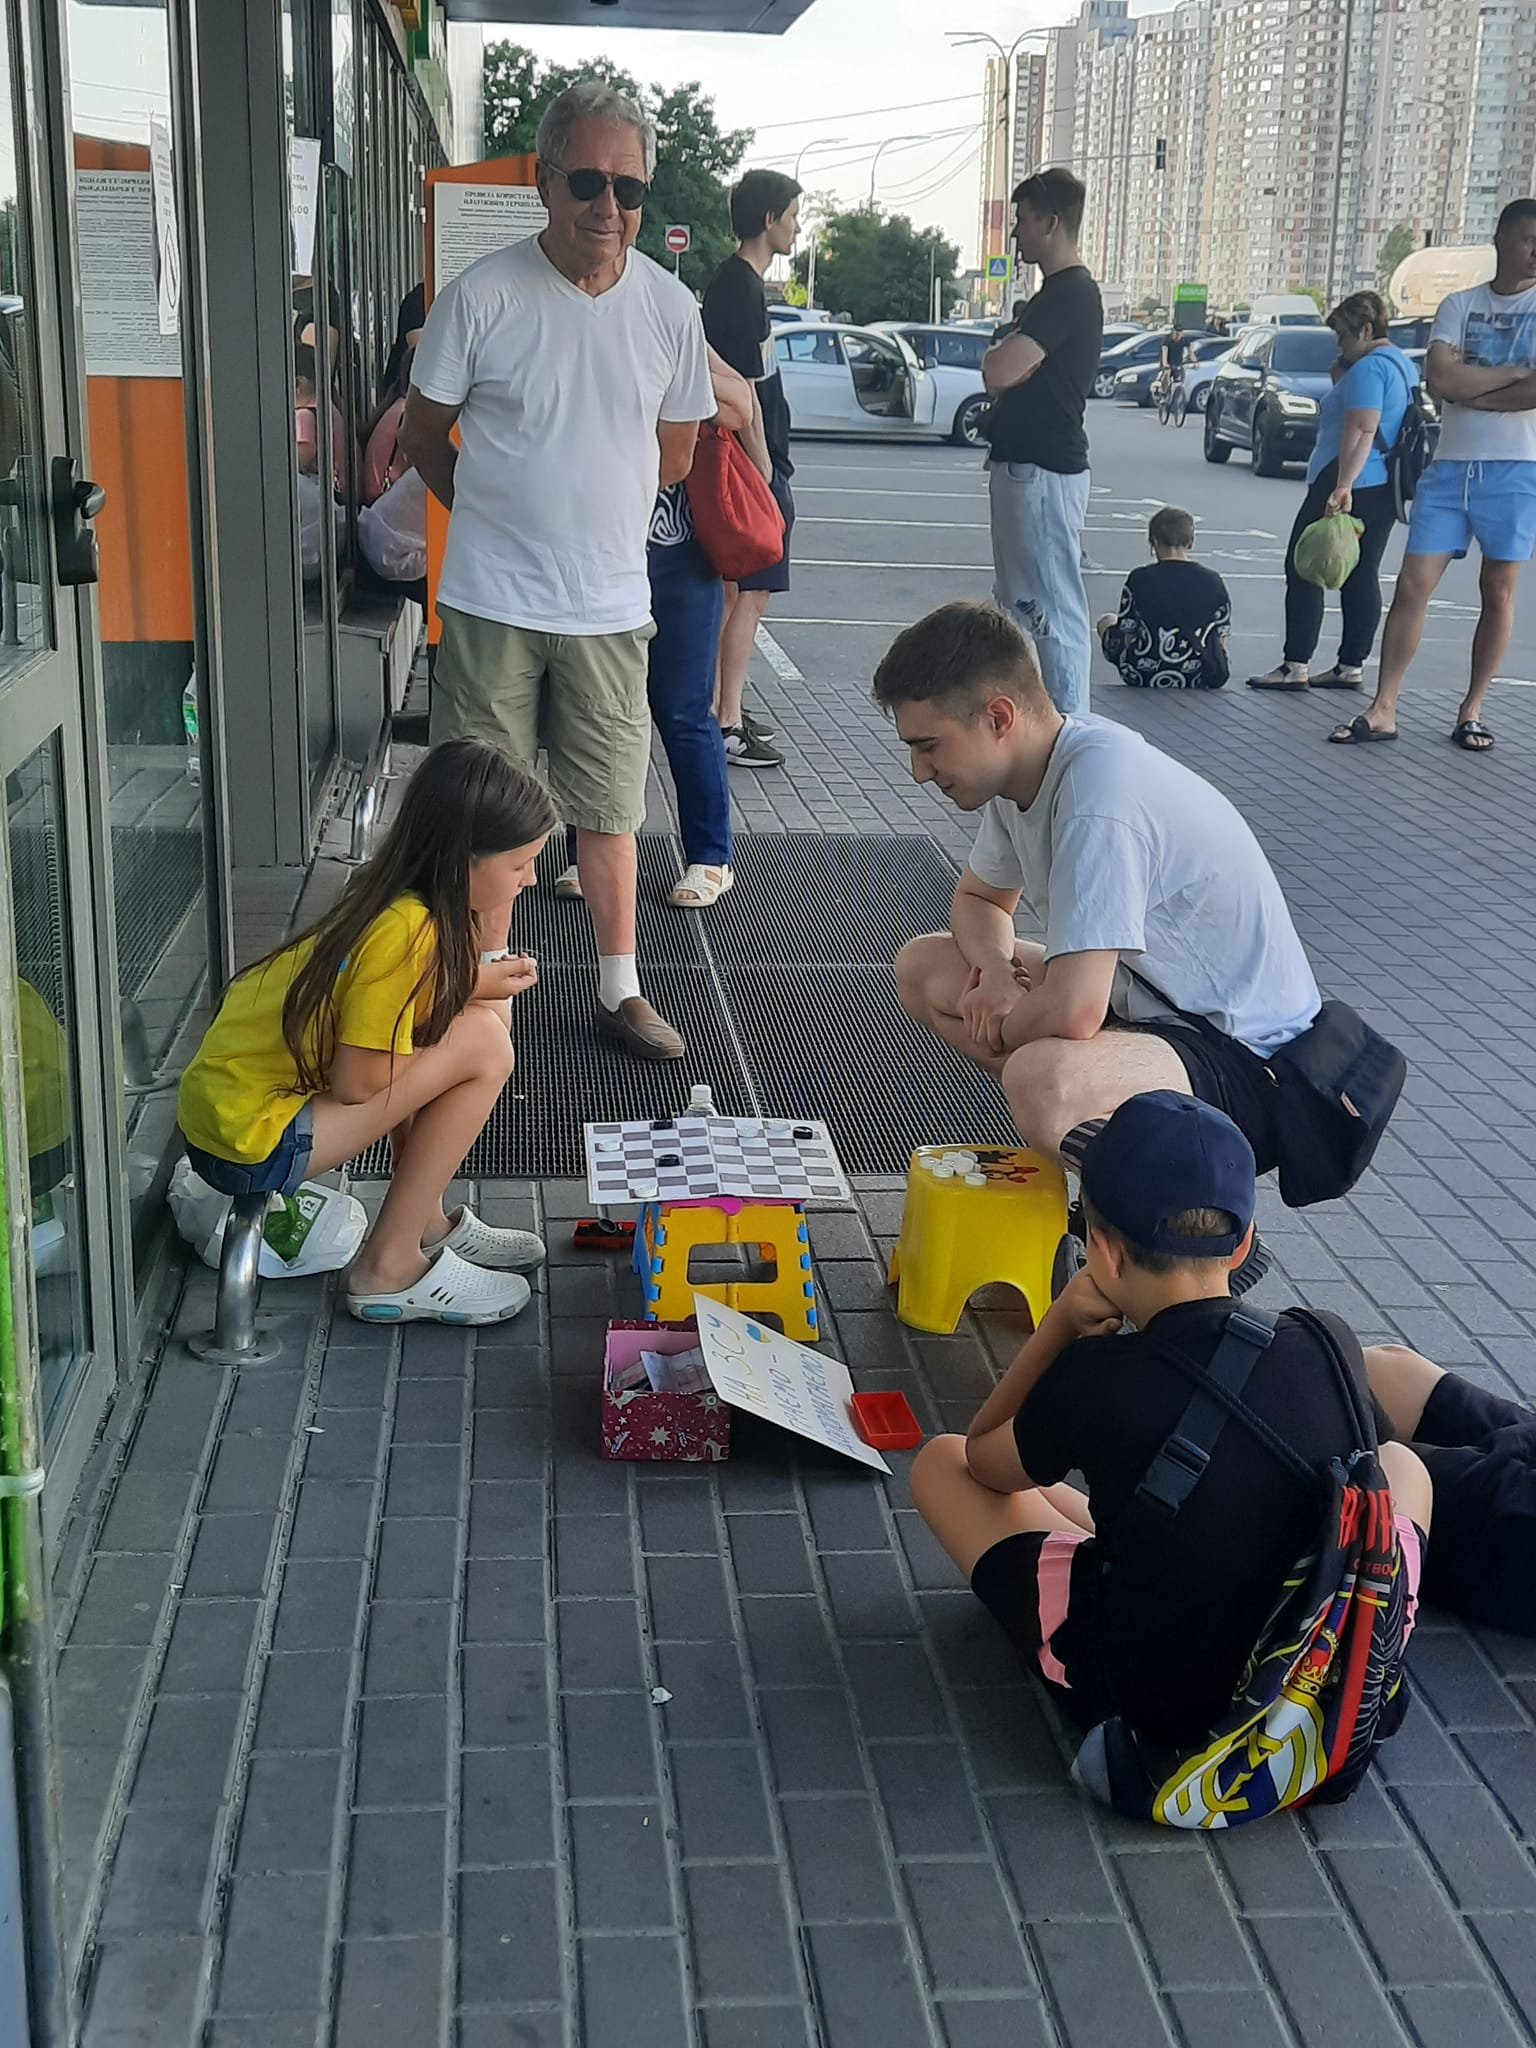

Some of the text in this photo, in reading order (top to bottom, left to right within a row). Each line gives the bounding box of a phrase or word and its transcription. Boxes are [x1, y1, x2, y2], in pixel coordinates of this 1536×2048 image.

[707, 1313, 768, 1410] НА ЗСУ
[768, 1367, 818, 1438] ГРАЄМО
